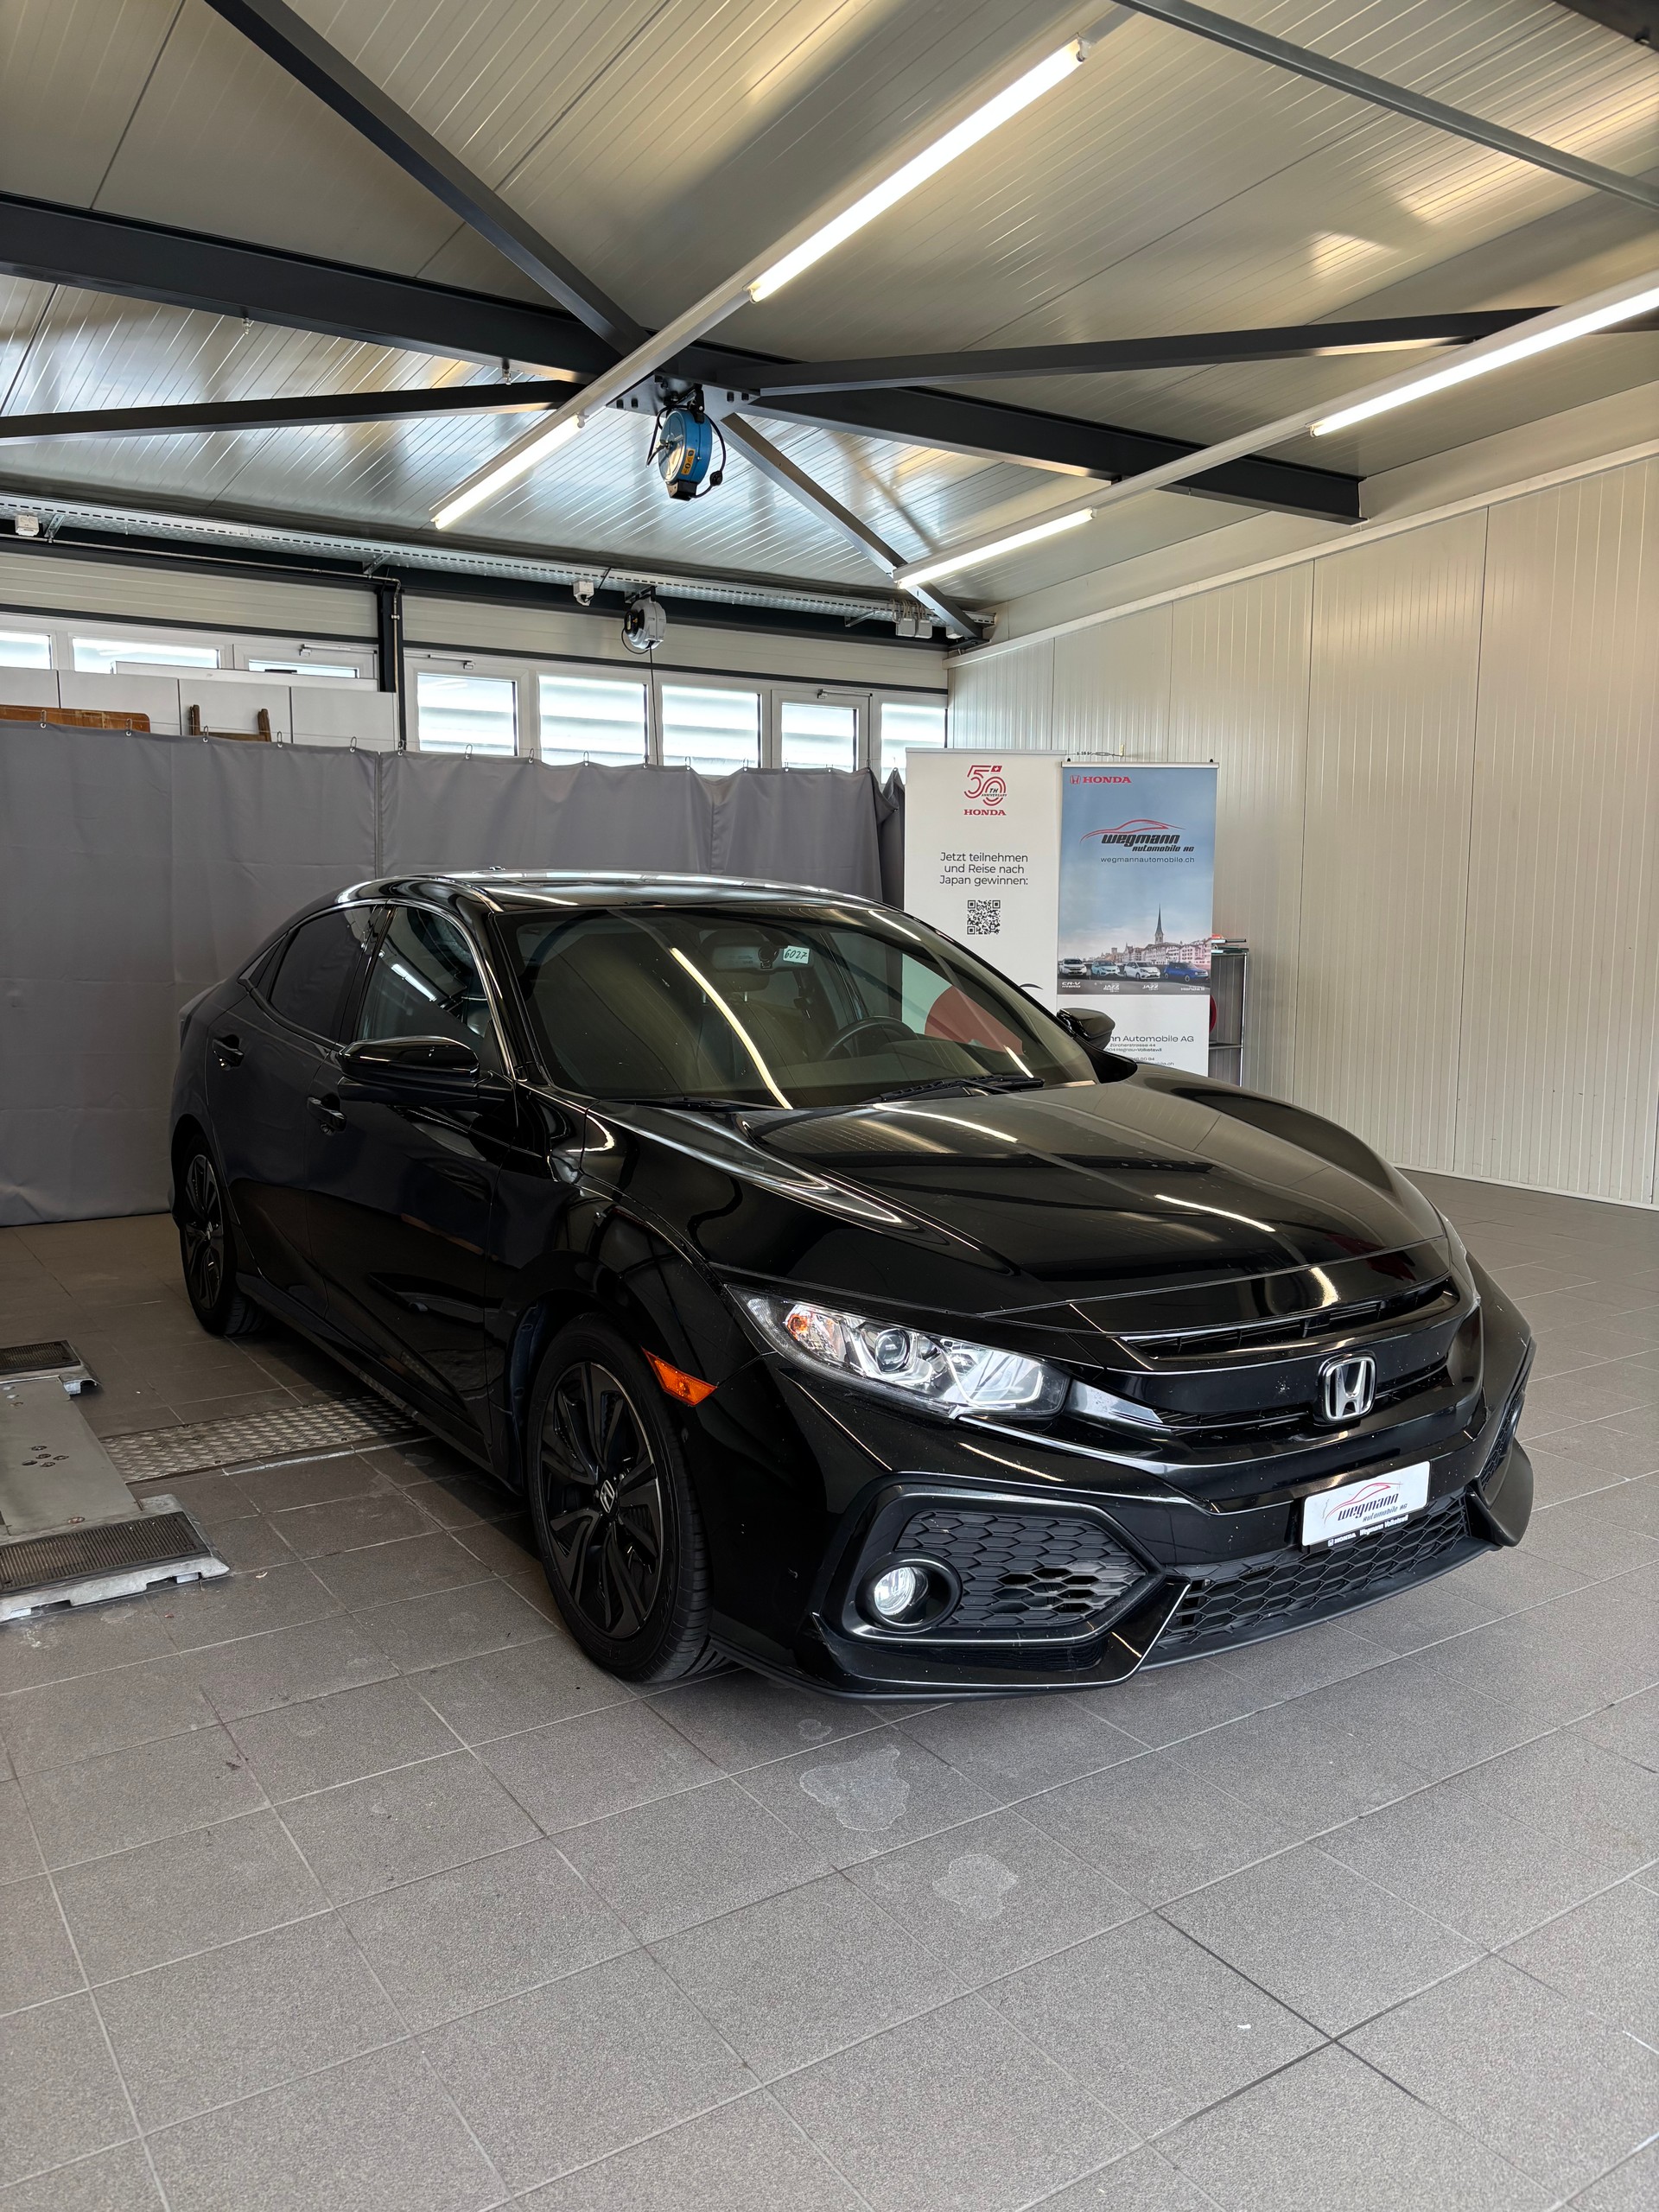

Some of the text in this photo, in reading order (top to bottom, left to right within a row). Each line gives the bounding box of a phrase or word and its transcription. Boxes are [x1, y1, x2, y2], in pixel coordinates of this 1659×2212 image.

[963, 765, 1006, 806] 50
[1102, 834, 1180, 847] wegmann
[940, 852, 1028, 862] Jetzt teilnehmen
[944, 864, 1025, 874] und Reise nach
[939, 875, 1028, 887] Japan gewinnen:
[784, 949, 808, 959] 6027
[1338, 1493, 1399, 1521] wegmann
